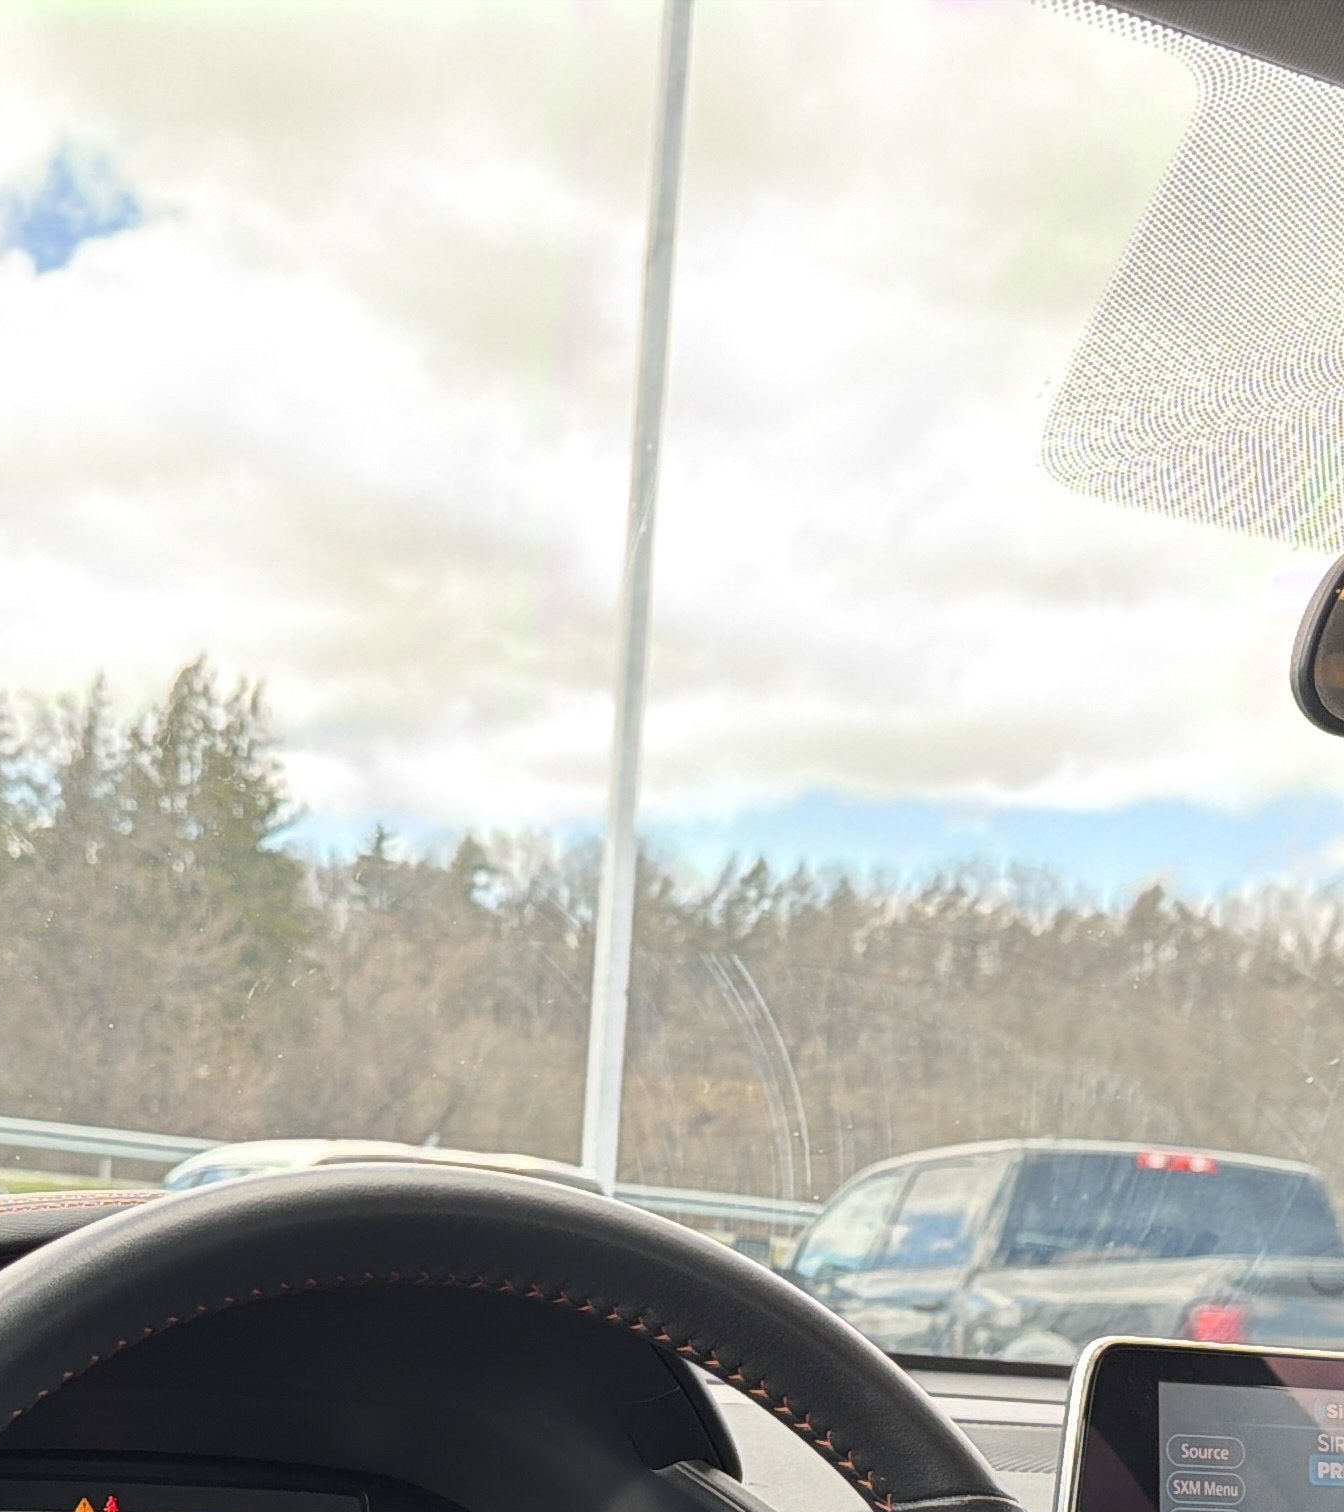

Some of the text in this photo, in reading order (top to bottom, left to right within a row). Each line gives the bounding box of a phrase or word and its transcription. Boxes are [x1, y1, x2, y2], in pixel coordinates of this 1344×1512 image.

[1181, 1443, 1230, 1461] Source
[1173, 1479, 1239, 1498] SXM Menu
